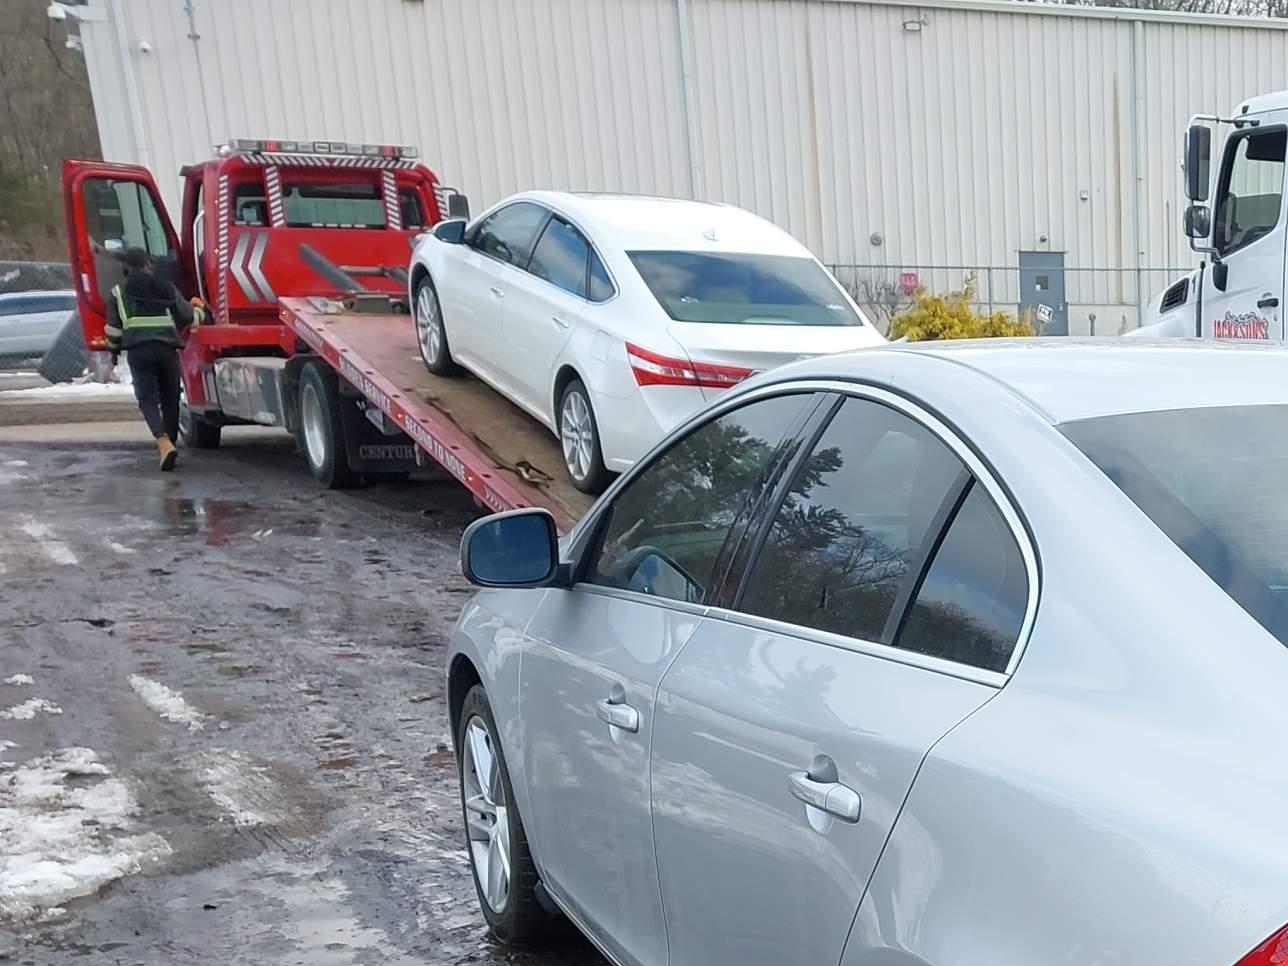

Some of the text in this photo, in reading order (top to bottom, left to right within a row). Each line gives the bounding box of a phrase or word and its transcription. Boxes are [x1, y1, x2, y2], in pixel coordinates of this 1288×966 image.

[404, 415, 466, 480] SECOND TO NONE
